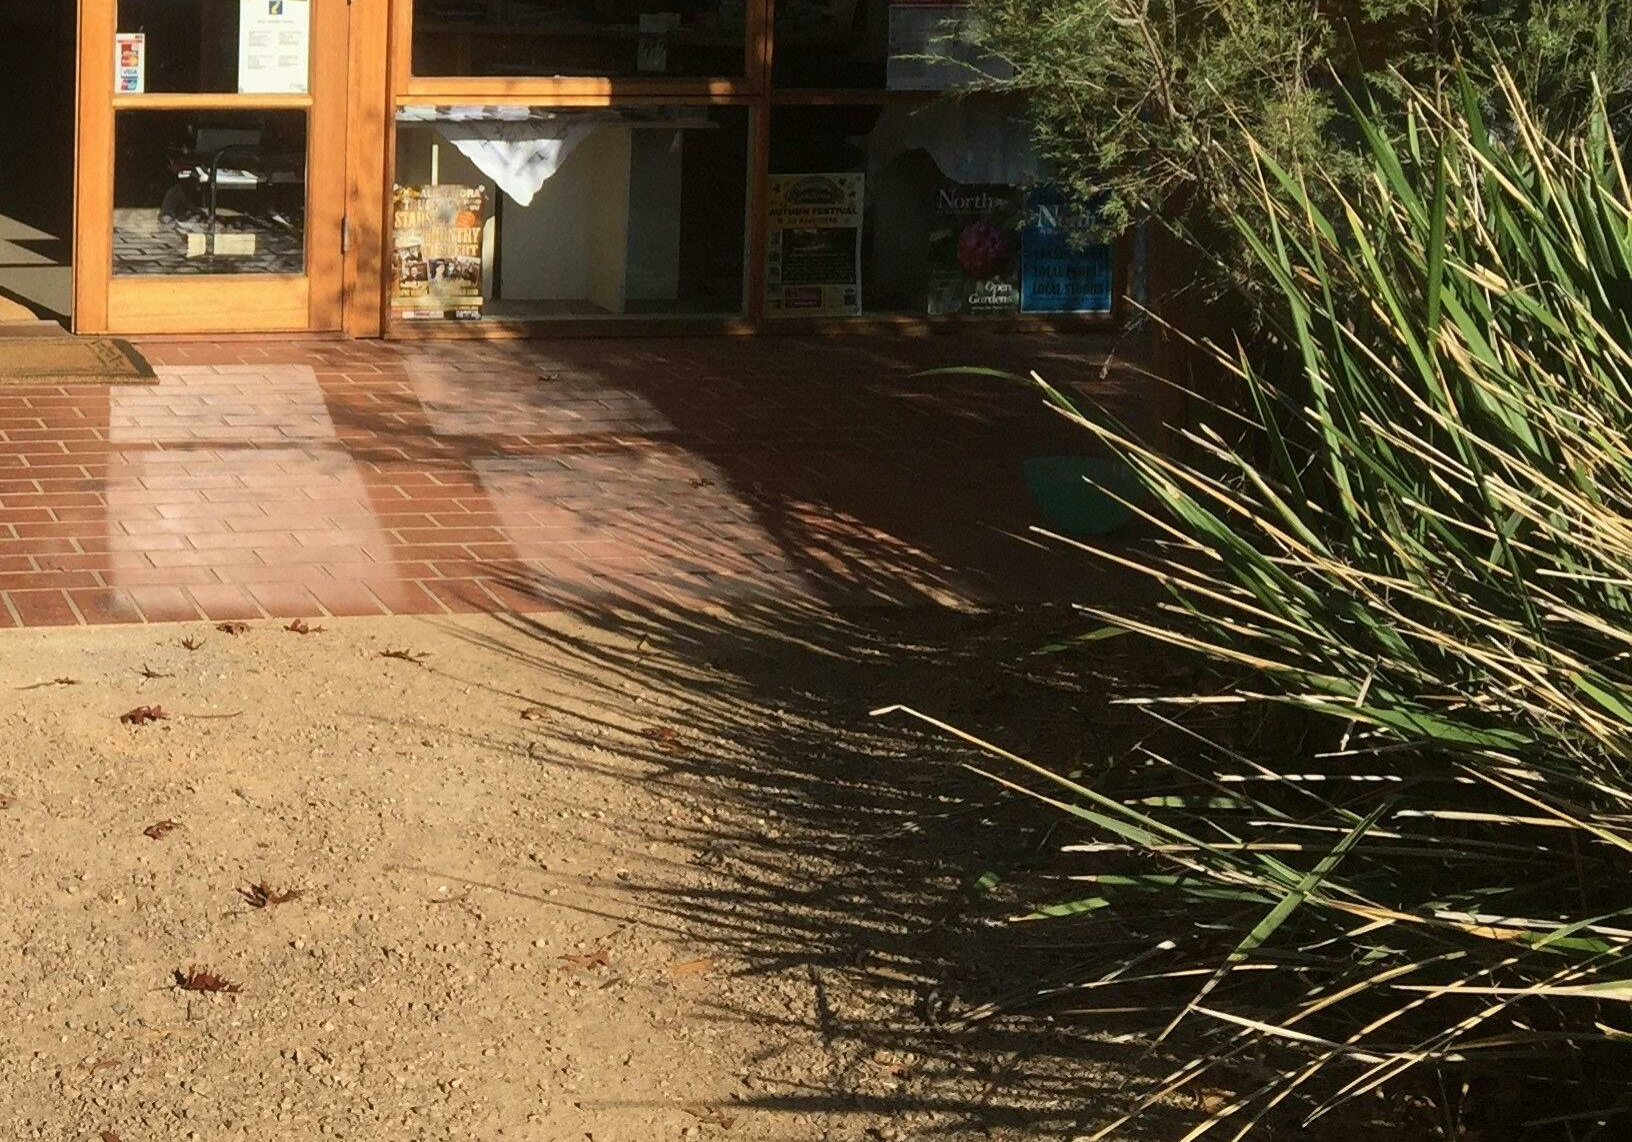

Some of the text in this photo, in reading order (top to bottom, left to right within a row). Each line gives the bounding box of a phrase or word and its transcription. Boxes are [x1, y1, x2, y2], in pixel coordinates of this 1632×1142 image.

[937, 189, 993, 210] North
[770, 207, 858, 216] AUTUMN FESTIVAL
[985, 281, 1012, 294] Open
[968, 292, 1013, 304] Gardens
